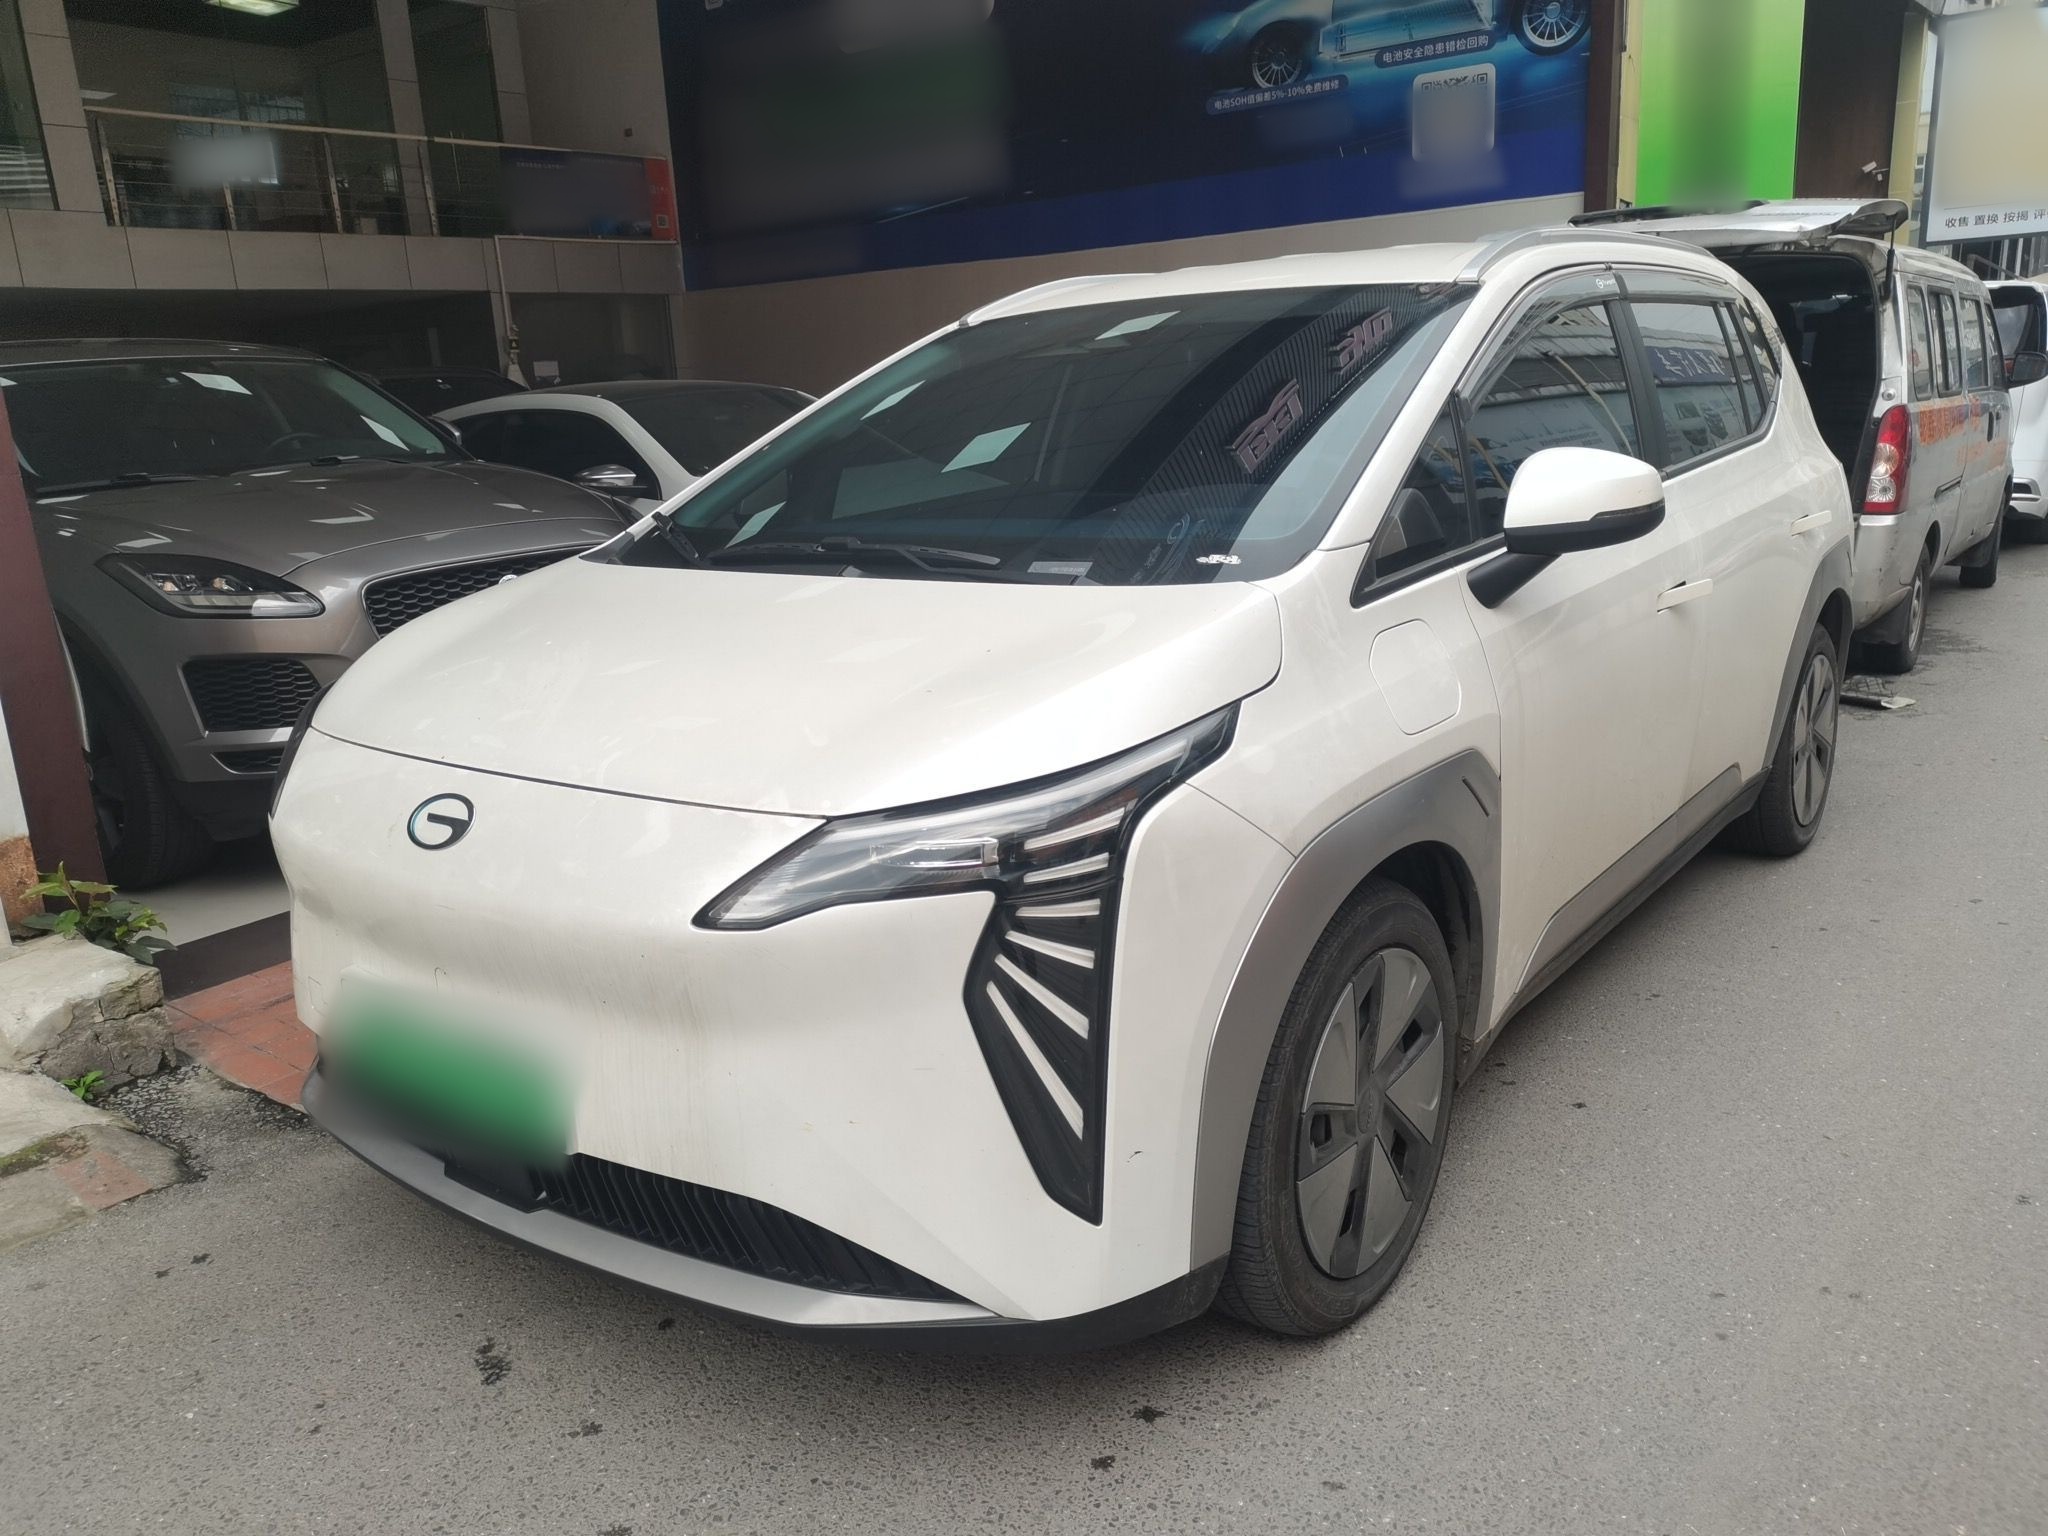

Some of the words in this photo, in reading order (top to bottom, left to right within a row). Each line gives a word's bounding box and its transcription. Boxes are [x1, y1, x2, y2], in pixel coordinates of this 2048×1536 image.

[1945, 216, 1970, 229] 收售
[1974, 213, 1999, 226] 置换
[2003, 210, 2029, 223] 按揭
[2033, 208, 2048, 220] 评
